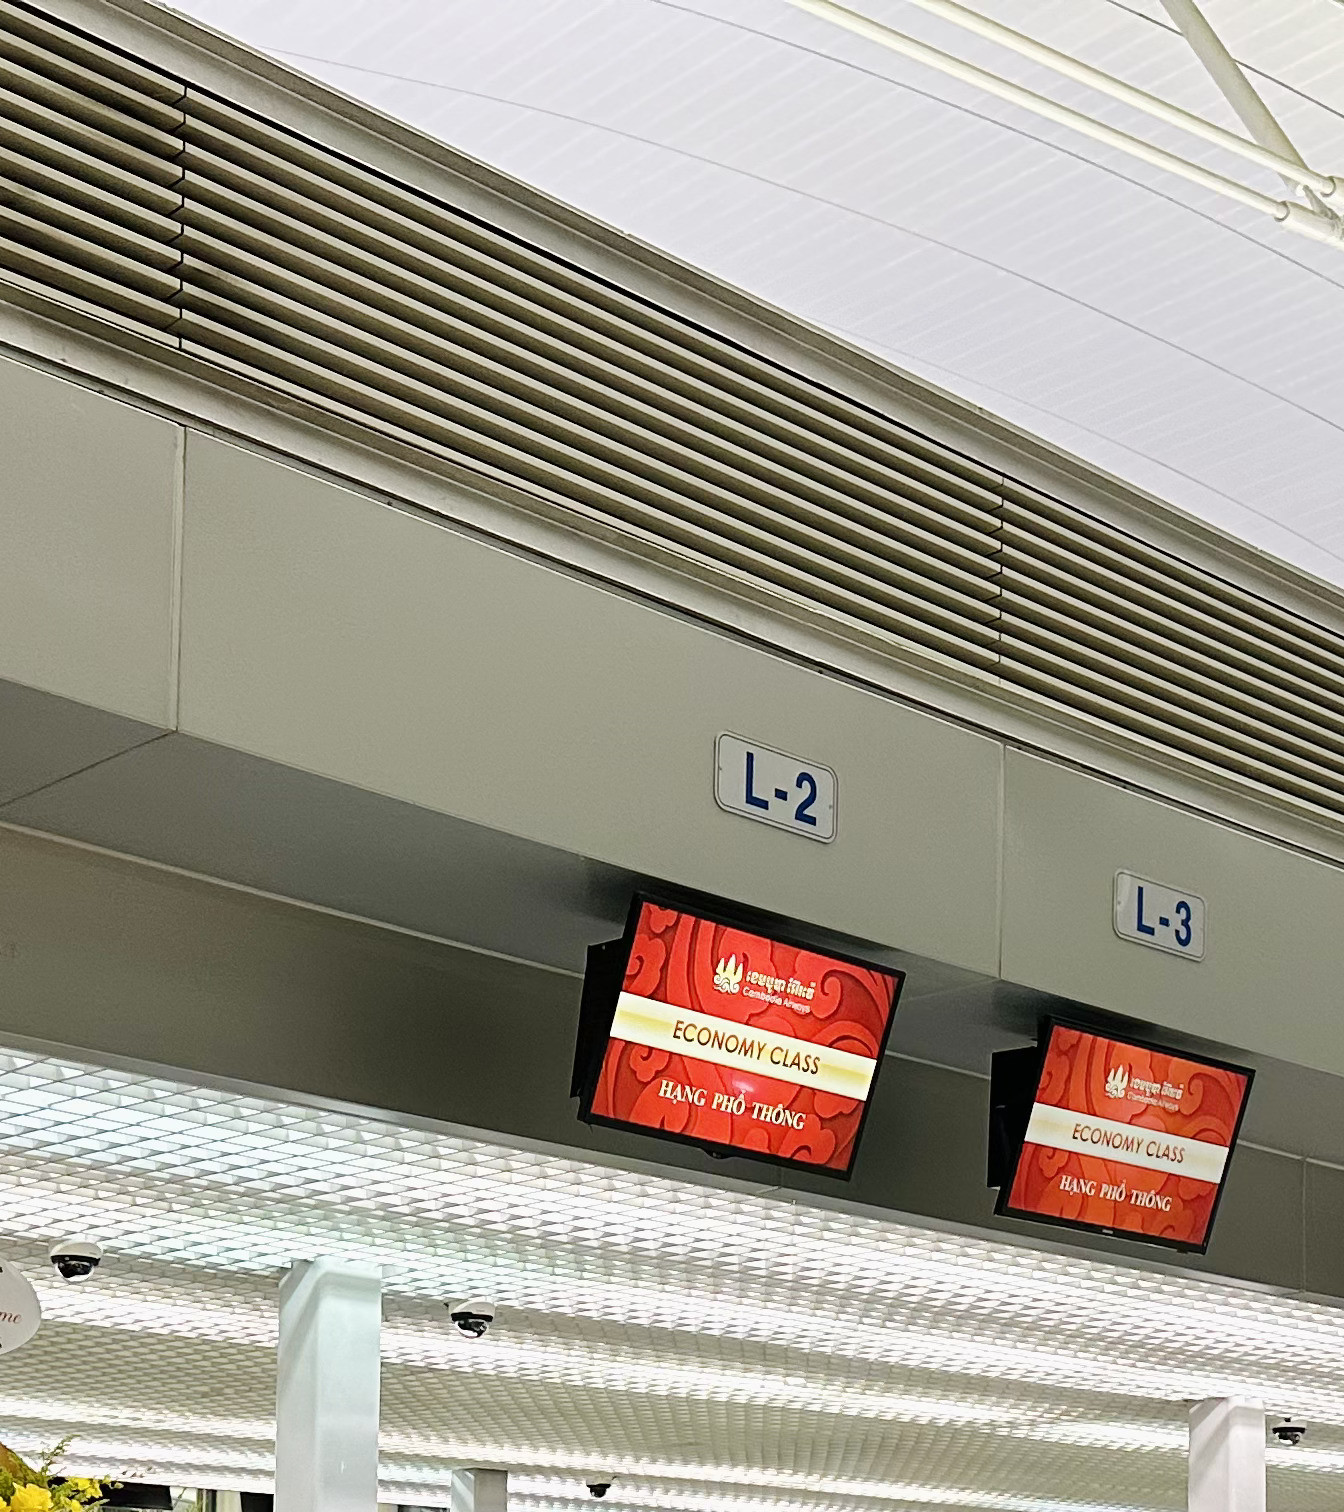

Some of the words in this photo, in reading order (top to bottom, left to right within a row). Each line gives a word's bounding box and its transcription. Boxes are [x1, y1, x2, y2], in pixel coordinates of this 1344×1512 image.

[745, 751, 817, 826] L-2
[1136, 886, 1192, 947] L-3
[673, 1019, 767, 1061] ECONOMY
[770, 1045, 821, 1075] CLASS
[658, 1079, 706, 1109] HẠNG
[752, 1101, 806, 1130] THÔNG
[1072, 1124, 1143, 1153] ECONOMY
[1146, 1141, 1185, 1164] CLASS
[1059, 1175, 1097, 1195] HẠNG
[1130, 1188, 1172, 1212] THÔNG
